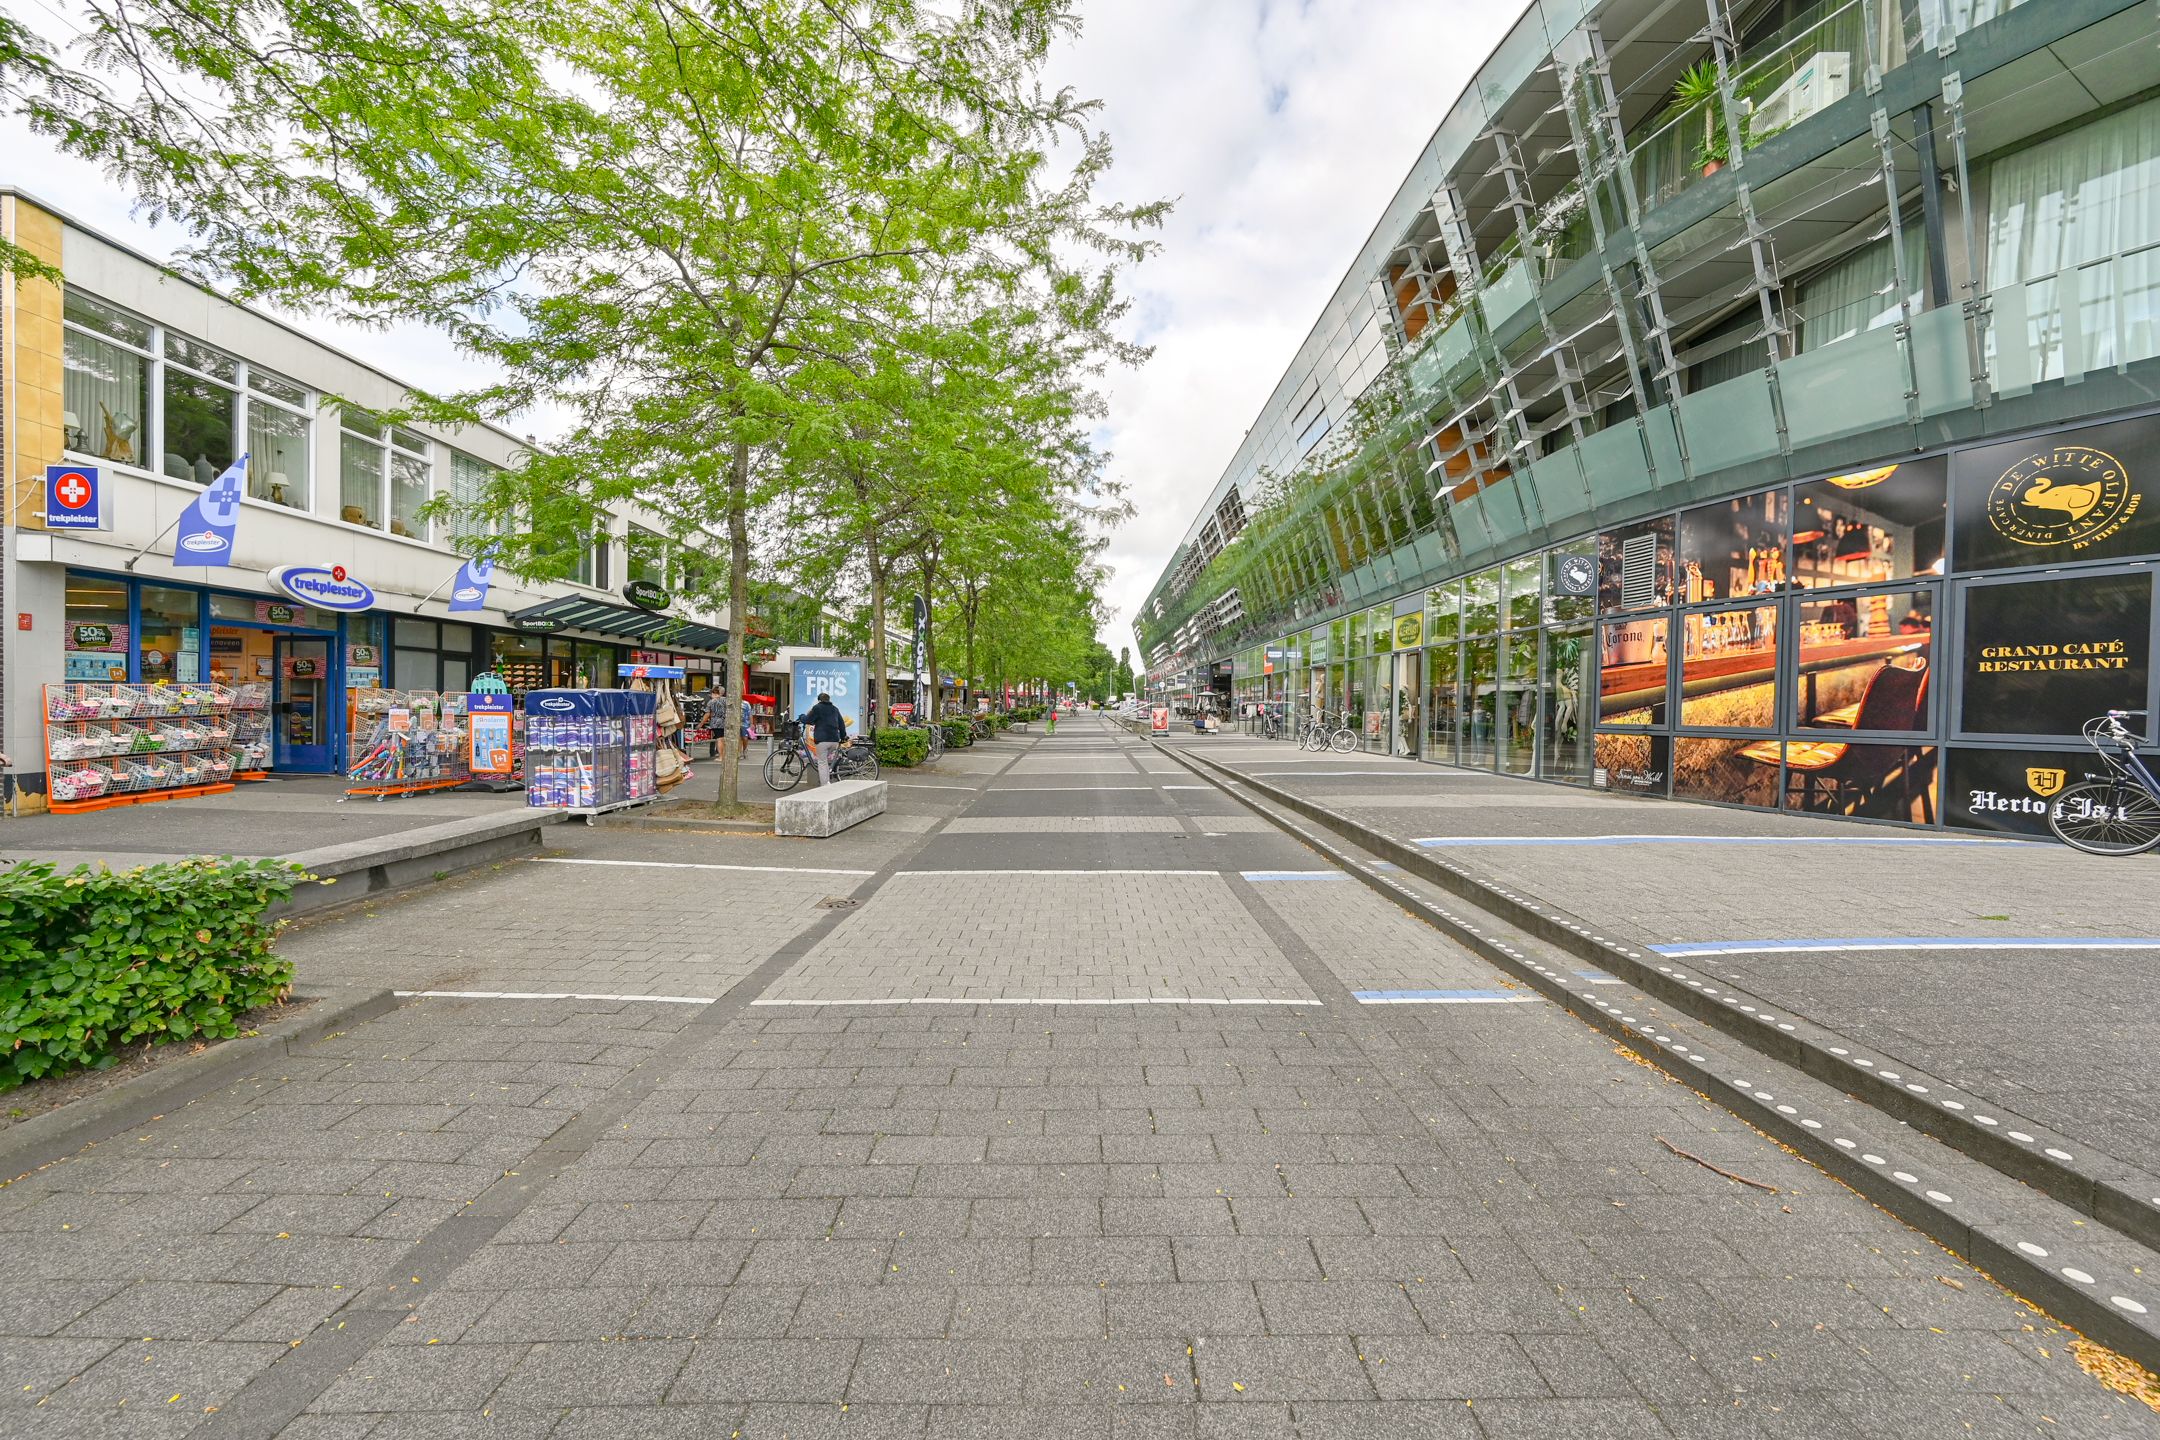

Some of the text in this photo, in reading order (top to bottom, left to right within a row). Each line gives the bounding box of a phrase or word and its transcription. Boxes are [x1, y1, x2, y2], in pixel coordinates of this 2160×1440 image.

[2001, 452, 2120, 537] DE WITTE OLIFANT
[48, 514, 97, 525] trekpleister
[2072, 493, 2142, 551] BY TIFF & ROB
[186, 539, 221, 547] trekpleister
[294, 577, 364, 599] trekpleister
[80, 627, 106, 637] 50%
[80, 635, 106, 643] korting
[1981, 639, 2125, 659] GRAND CAFÉ
[1978, 657, 2129, 673] RESTAURANT
[806, 676, 848, 697] FRIS
[493, 753, 508, 764] 1+1
